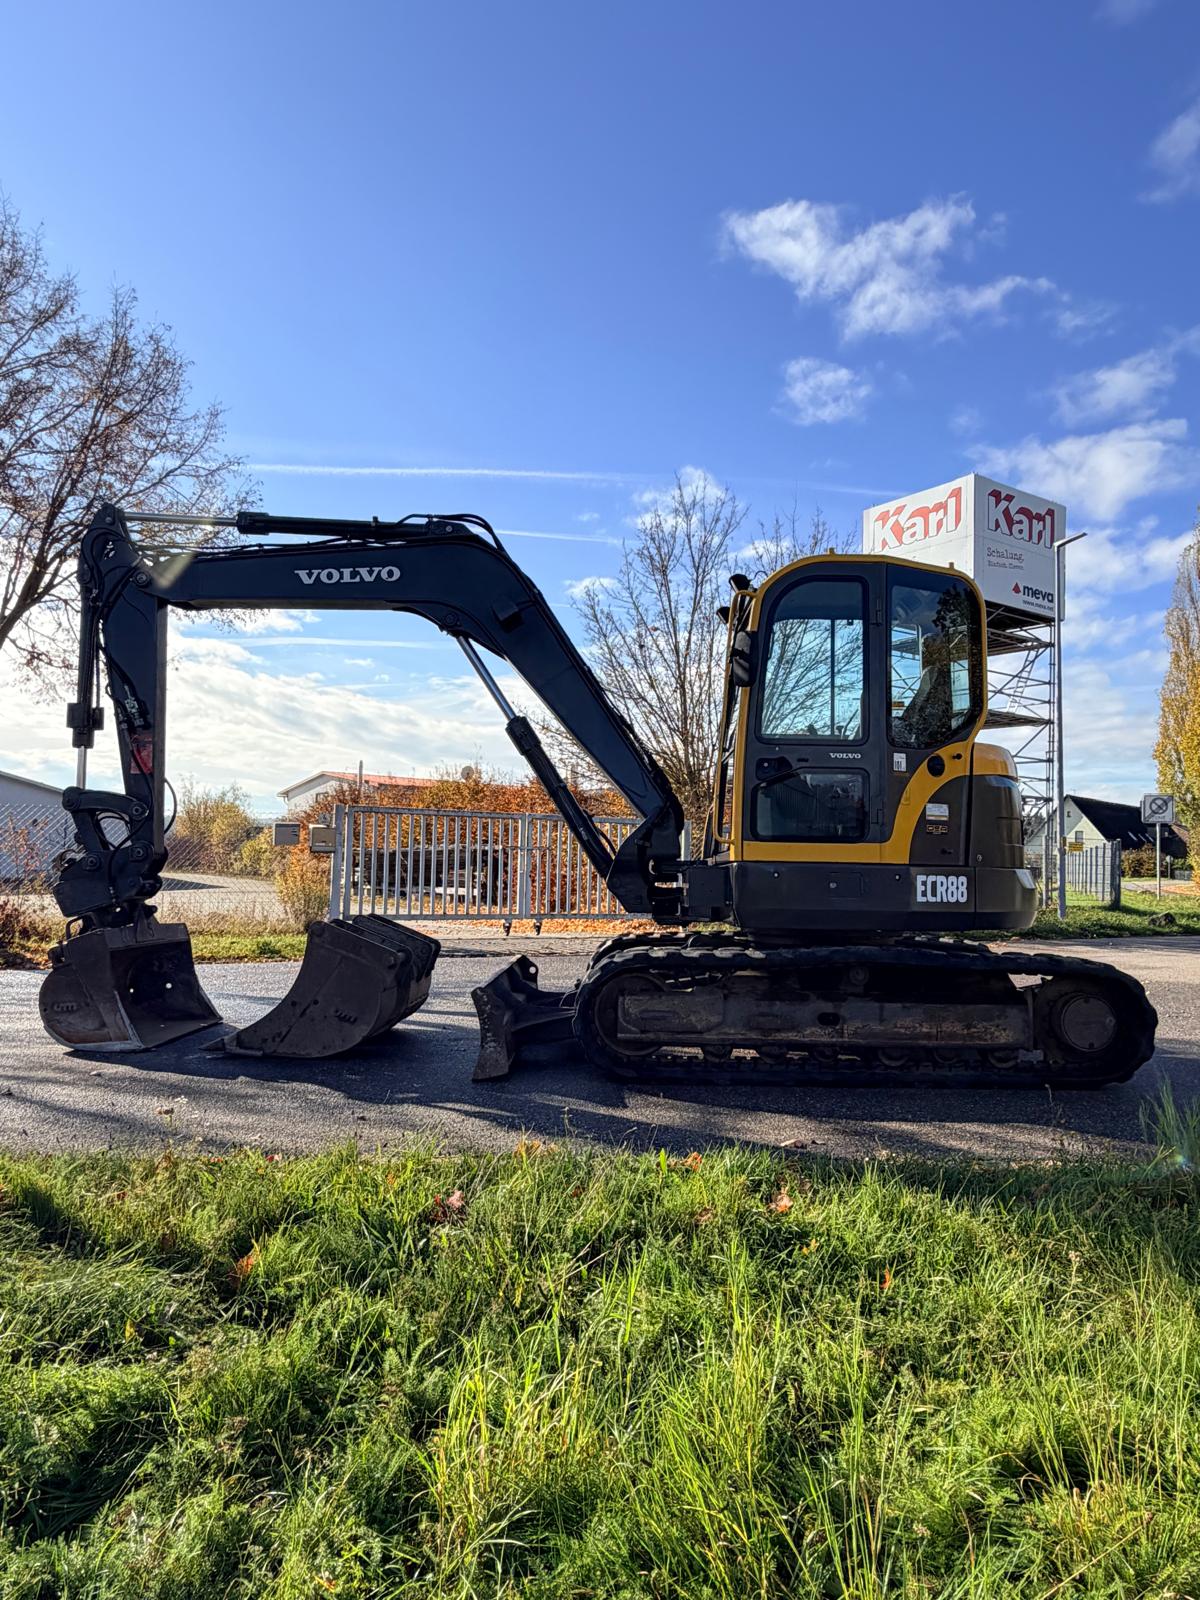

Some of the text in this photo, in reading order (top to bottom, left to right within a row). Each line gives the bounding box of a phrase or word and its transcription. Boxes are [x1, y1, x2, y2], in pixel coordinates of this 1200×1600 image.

[873, 486, 962, 551] Karl
[987, 488, 1055, 549] Karl
[294, 566, 401, 585] VOLVO
[1023, 585, 1054, 604] meva
[916, 875, 968, 903] ECR88
